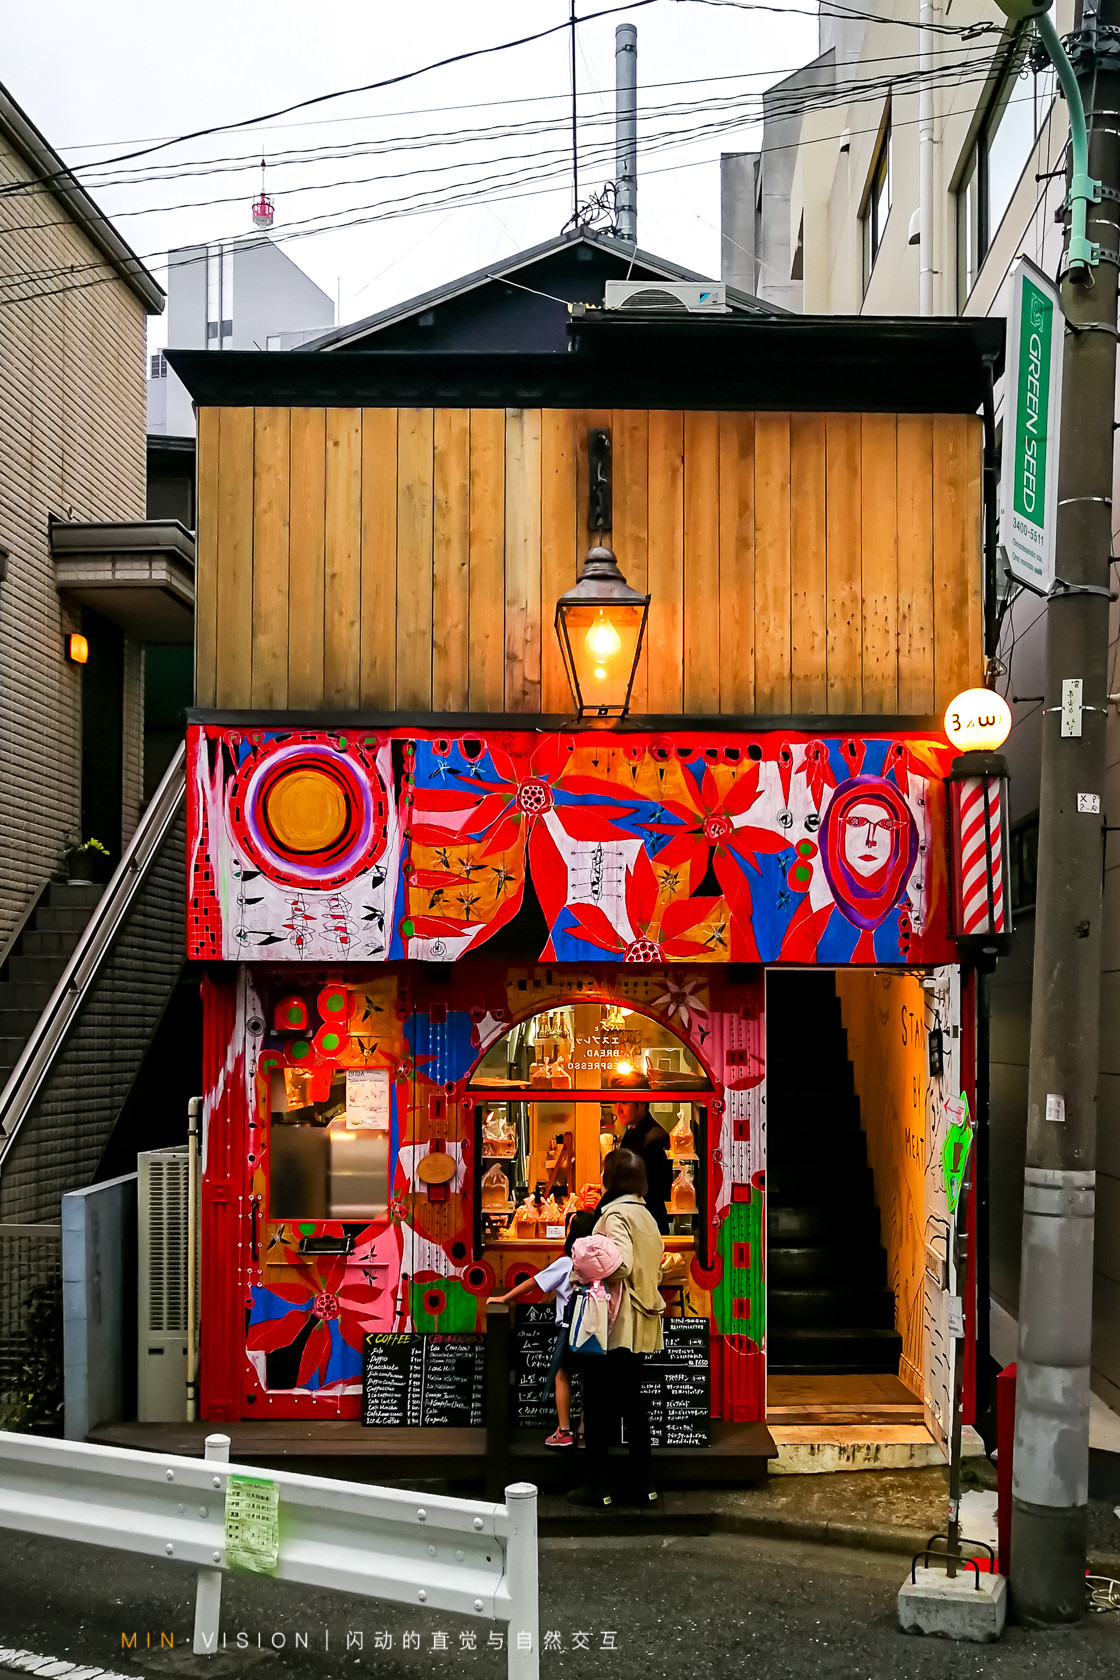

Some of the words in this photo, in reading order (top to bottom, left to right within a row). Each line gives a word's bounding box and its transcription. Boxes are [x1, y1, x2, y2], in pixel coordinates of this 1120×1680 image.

[1026, 333, 1041, 434] GREEN
[1024, 435, 1037, 513] SEED
[1013, 517, 1044, 547] 3400-5511
[905, 1127, 925, 1170] MEAT
[526, 1306, 555, 1322] 食パン
